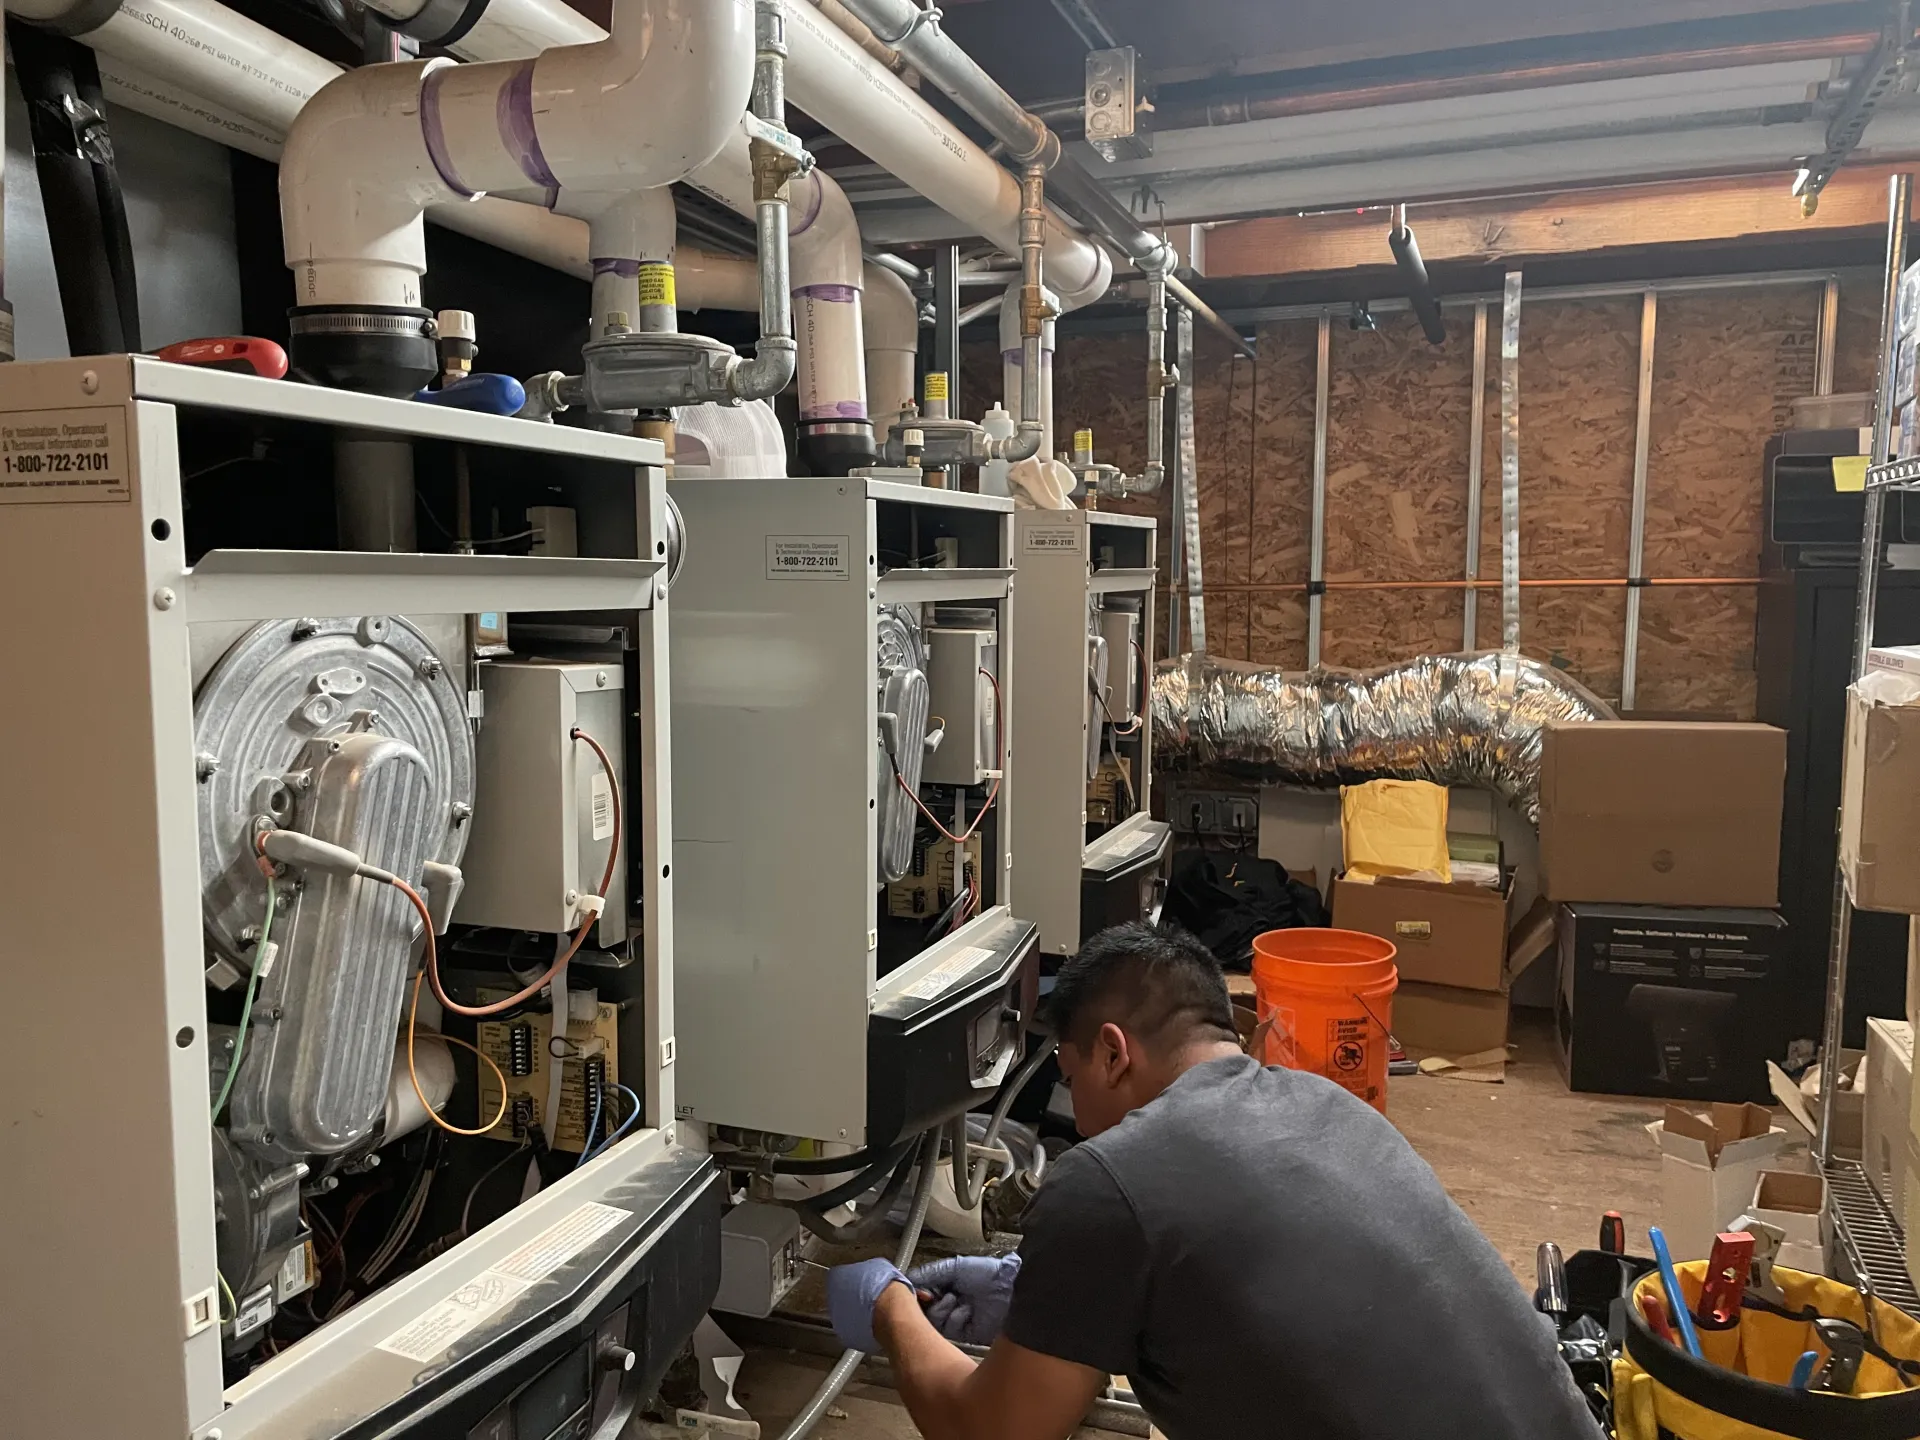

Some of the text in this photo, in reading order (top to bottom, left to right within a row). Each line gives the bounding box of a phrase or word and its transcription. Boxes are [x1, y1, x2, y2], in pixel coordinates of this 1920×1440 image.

[144, 13, 169, 33] SCH
[171, 26, 186, 41] 40
[185, 35, 201, 48] 260
[201, 43, 216, 56] PSI
[216, 51, 242, 68] WATER
[241, 62, 253, 74] AT
[269, 76, 284, 90] PVC
[284, 82, 302, 97] 1120
[806, 297, 815, 317] SCH
[807, 320, 815, 332] 40
[4, 453, 109, 473] 1-800-722-2101
[776, 556, 838, 566] 1-800-722-2101
[676, 1104, 695, 1115] LET
